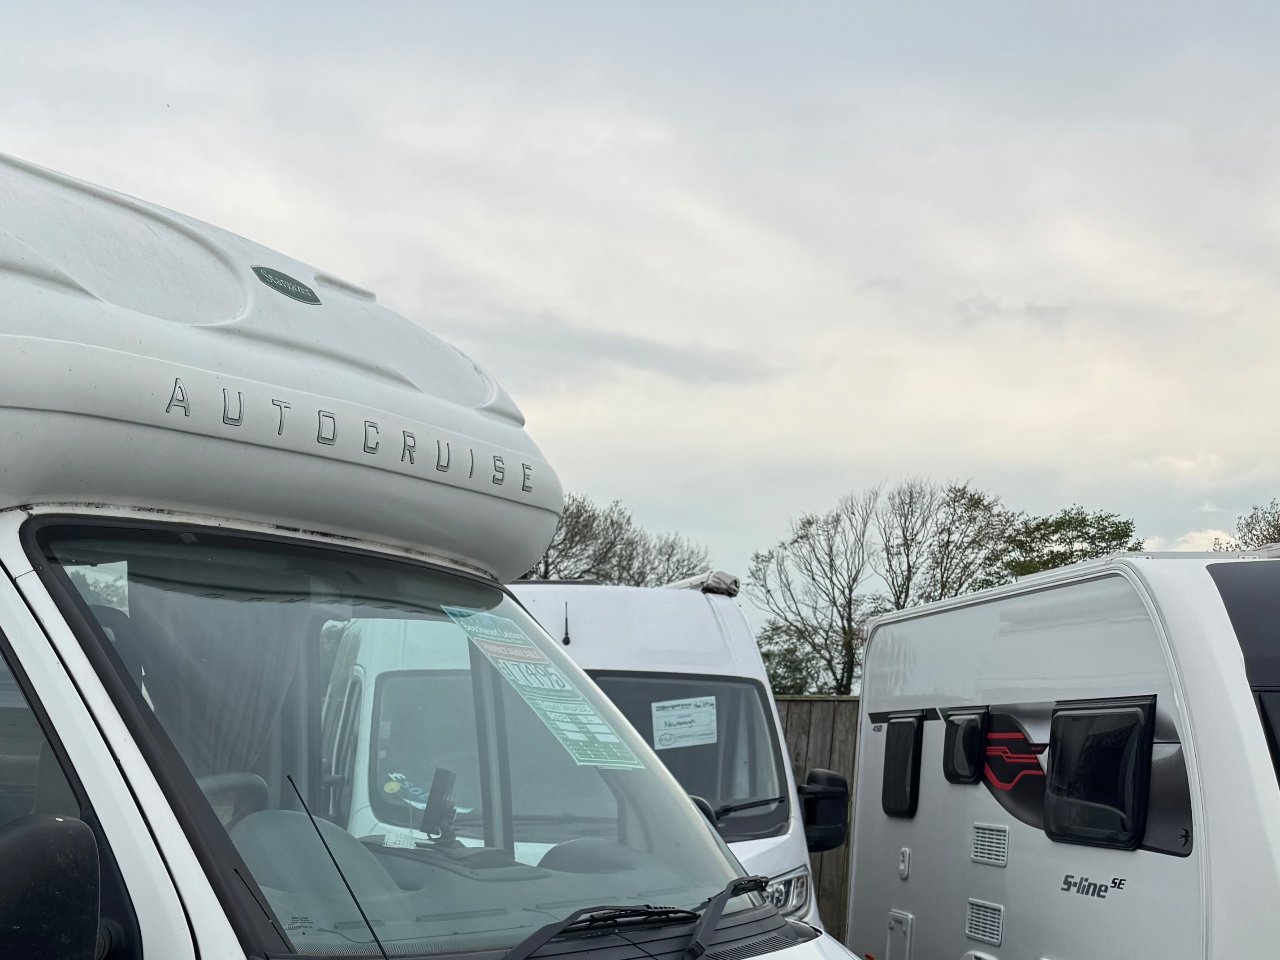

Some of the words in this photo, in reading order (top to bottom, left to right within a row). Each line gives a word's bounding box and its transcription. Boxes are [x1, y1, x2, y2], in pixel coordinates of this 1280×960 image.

[165, 377, 533, 493] AUTOCRUISE
[1060, 874, 1109, 899] S-line
[1110, 877, 1127, 890] SE
